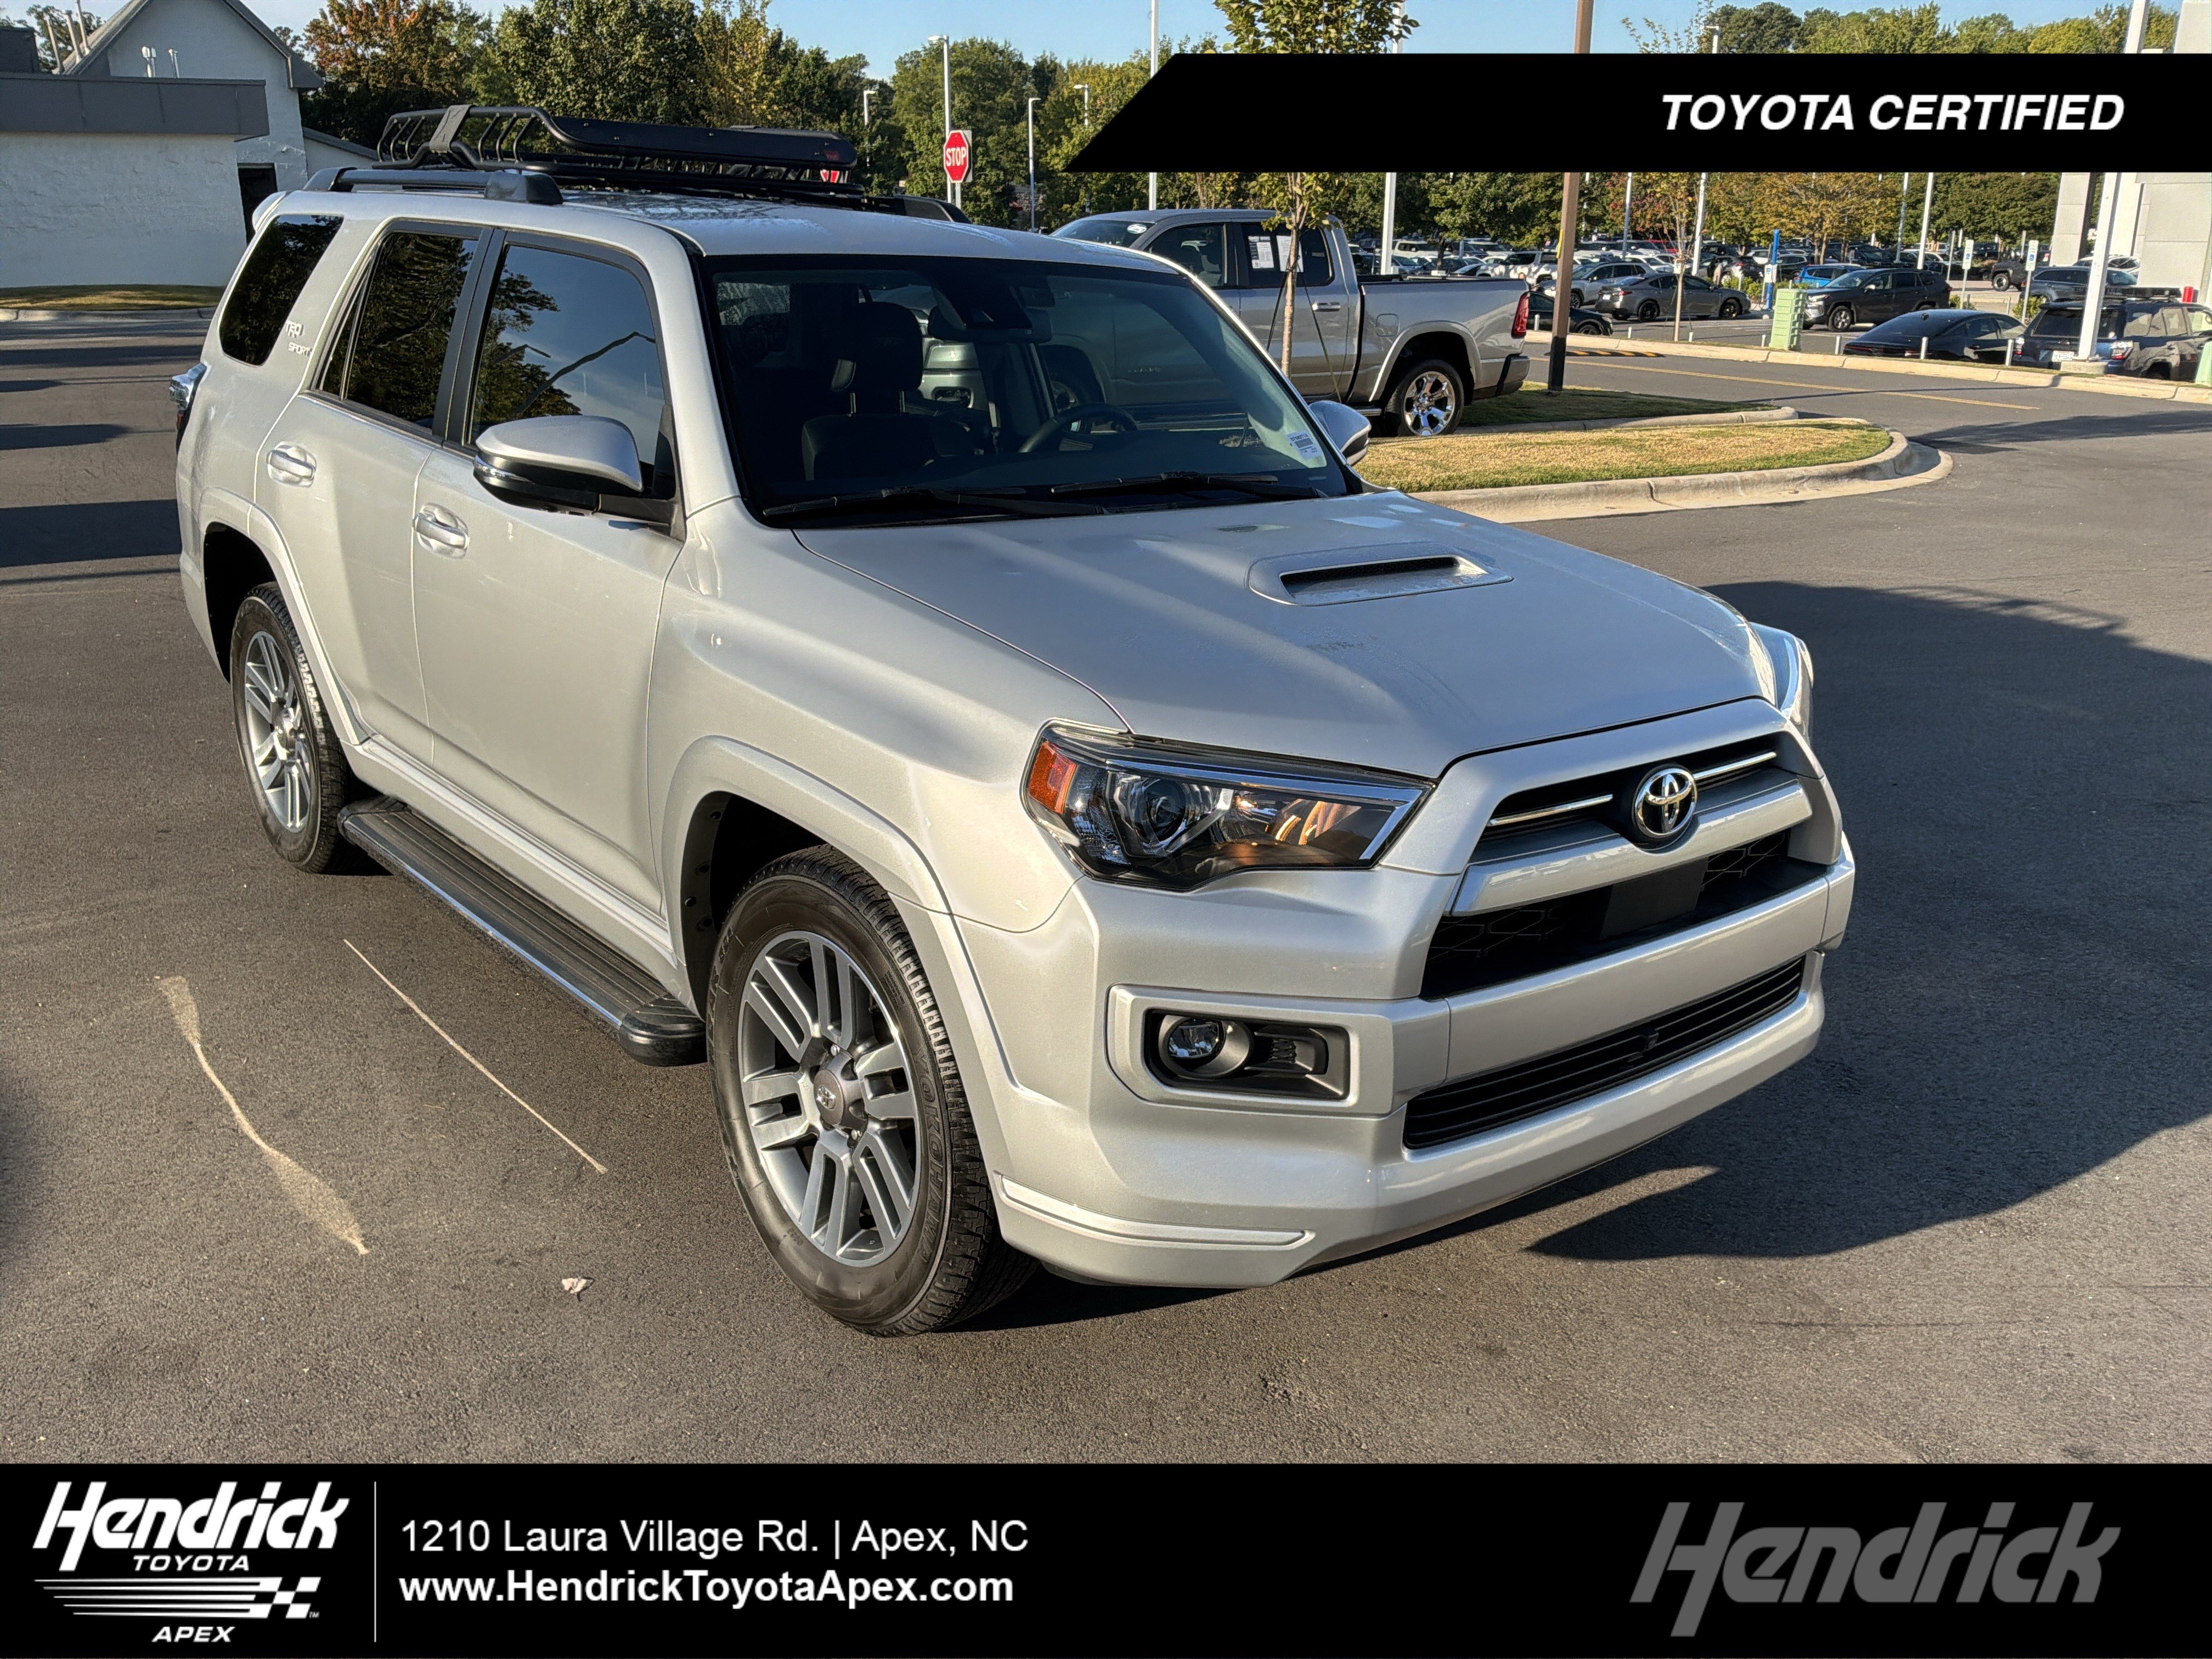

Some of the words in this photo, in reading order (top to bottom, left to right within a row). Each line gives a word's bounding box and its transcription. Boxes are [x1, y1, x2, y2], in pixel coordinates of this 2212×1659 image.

[946, 147, 966, 167] STOP
[289, 342, 312, 357] SPORT
[913, 1046, 945, 1263] YOKOHAMA
